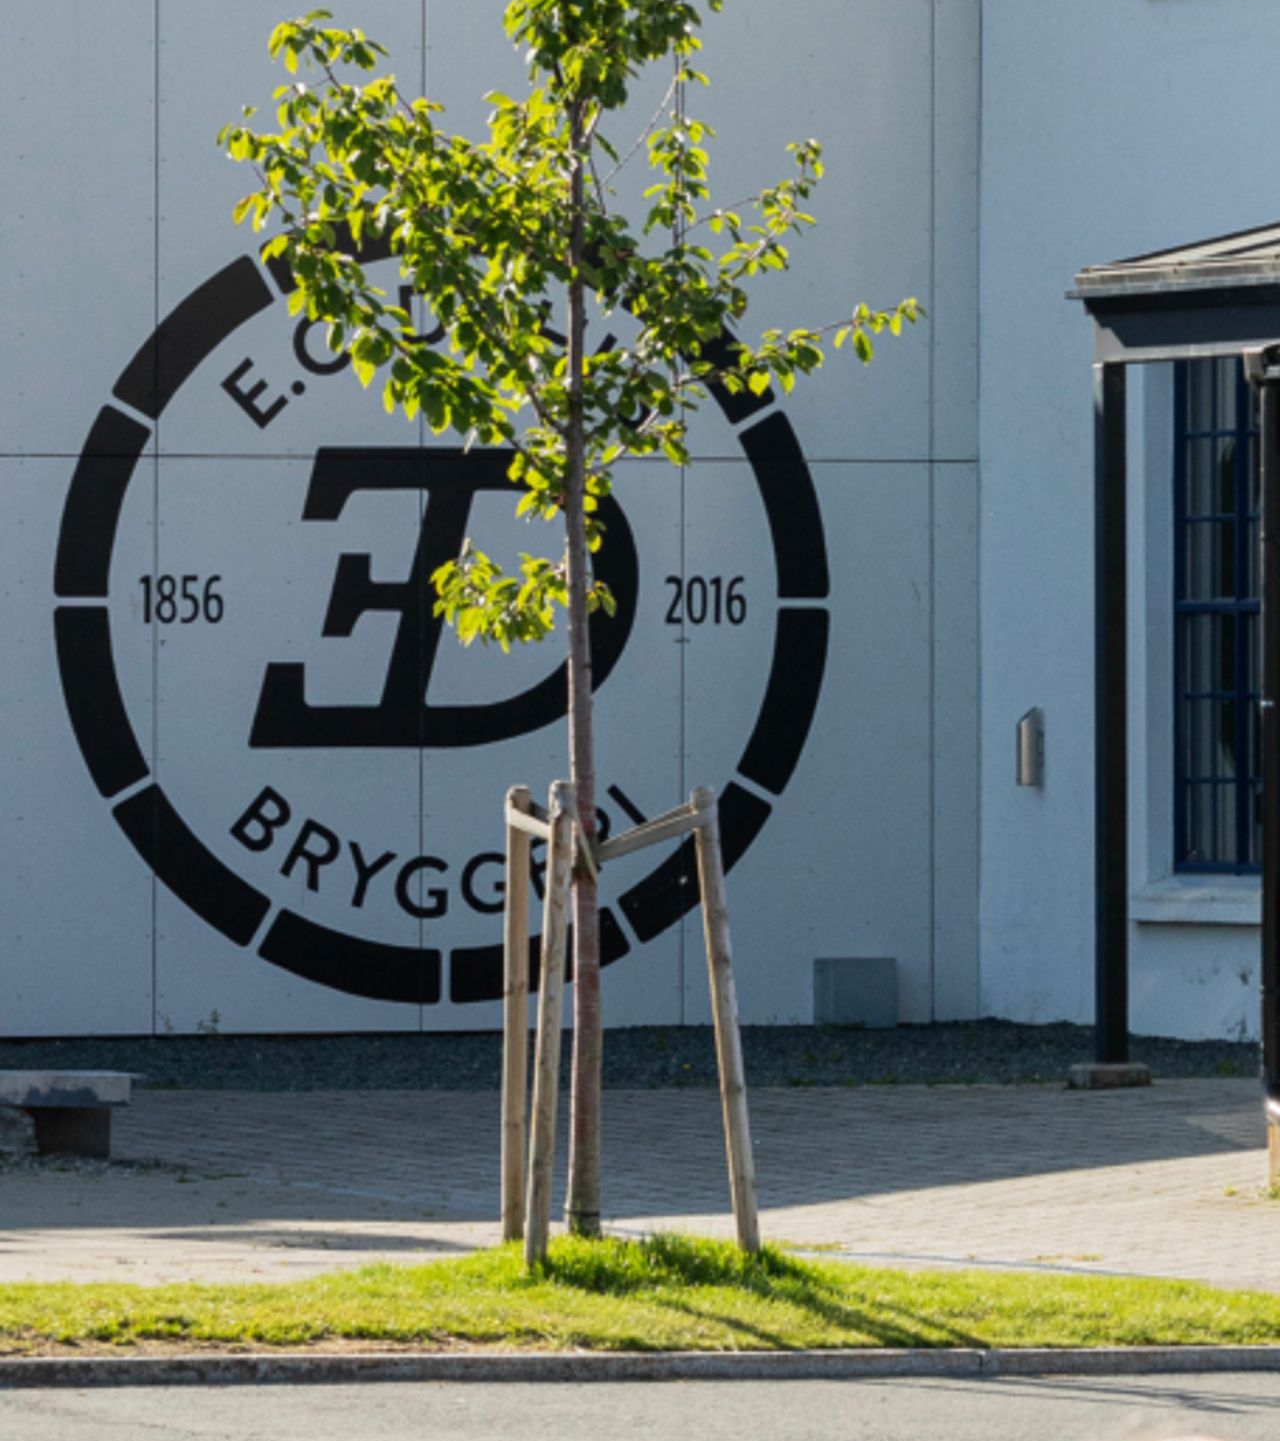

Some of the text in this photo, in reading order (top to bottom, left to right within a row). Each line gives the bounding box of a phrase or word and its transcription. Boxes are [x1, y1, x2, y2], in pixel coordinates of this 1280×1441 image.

[138, 574, 747, 626] 1856 2016
[229, 785, 648, 919] BRYGGI
